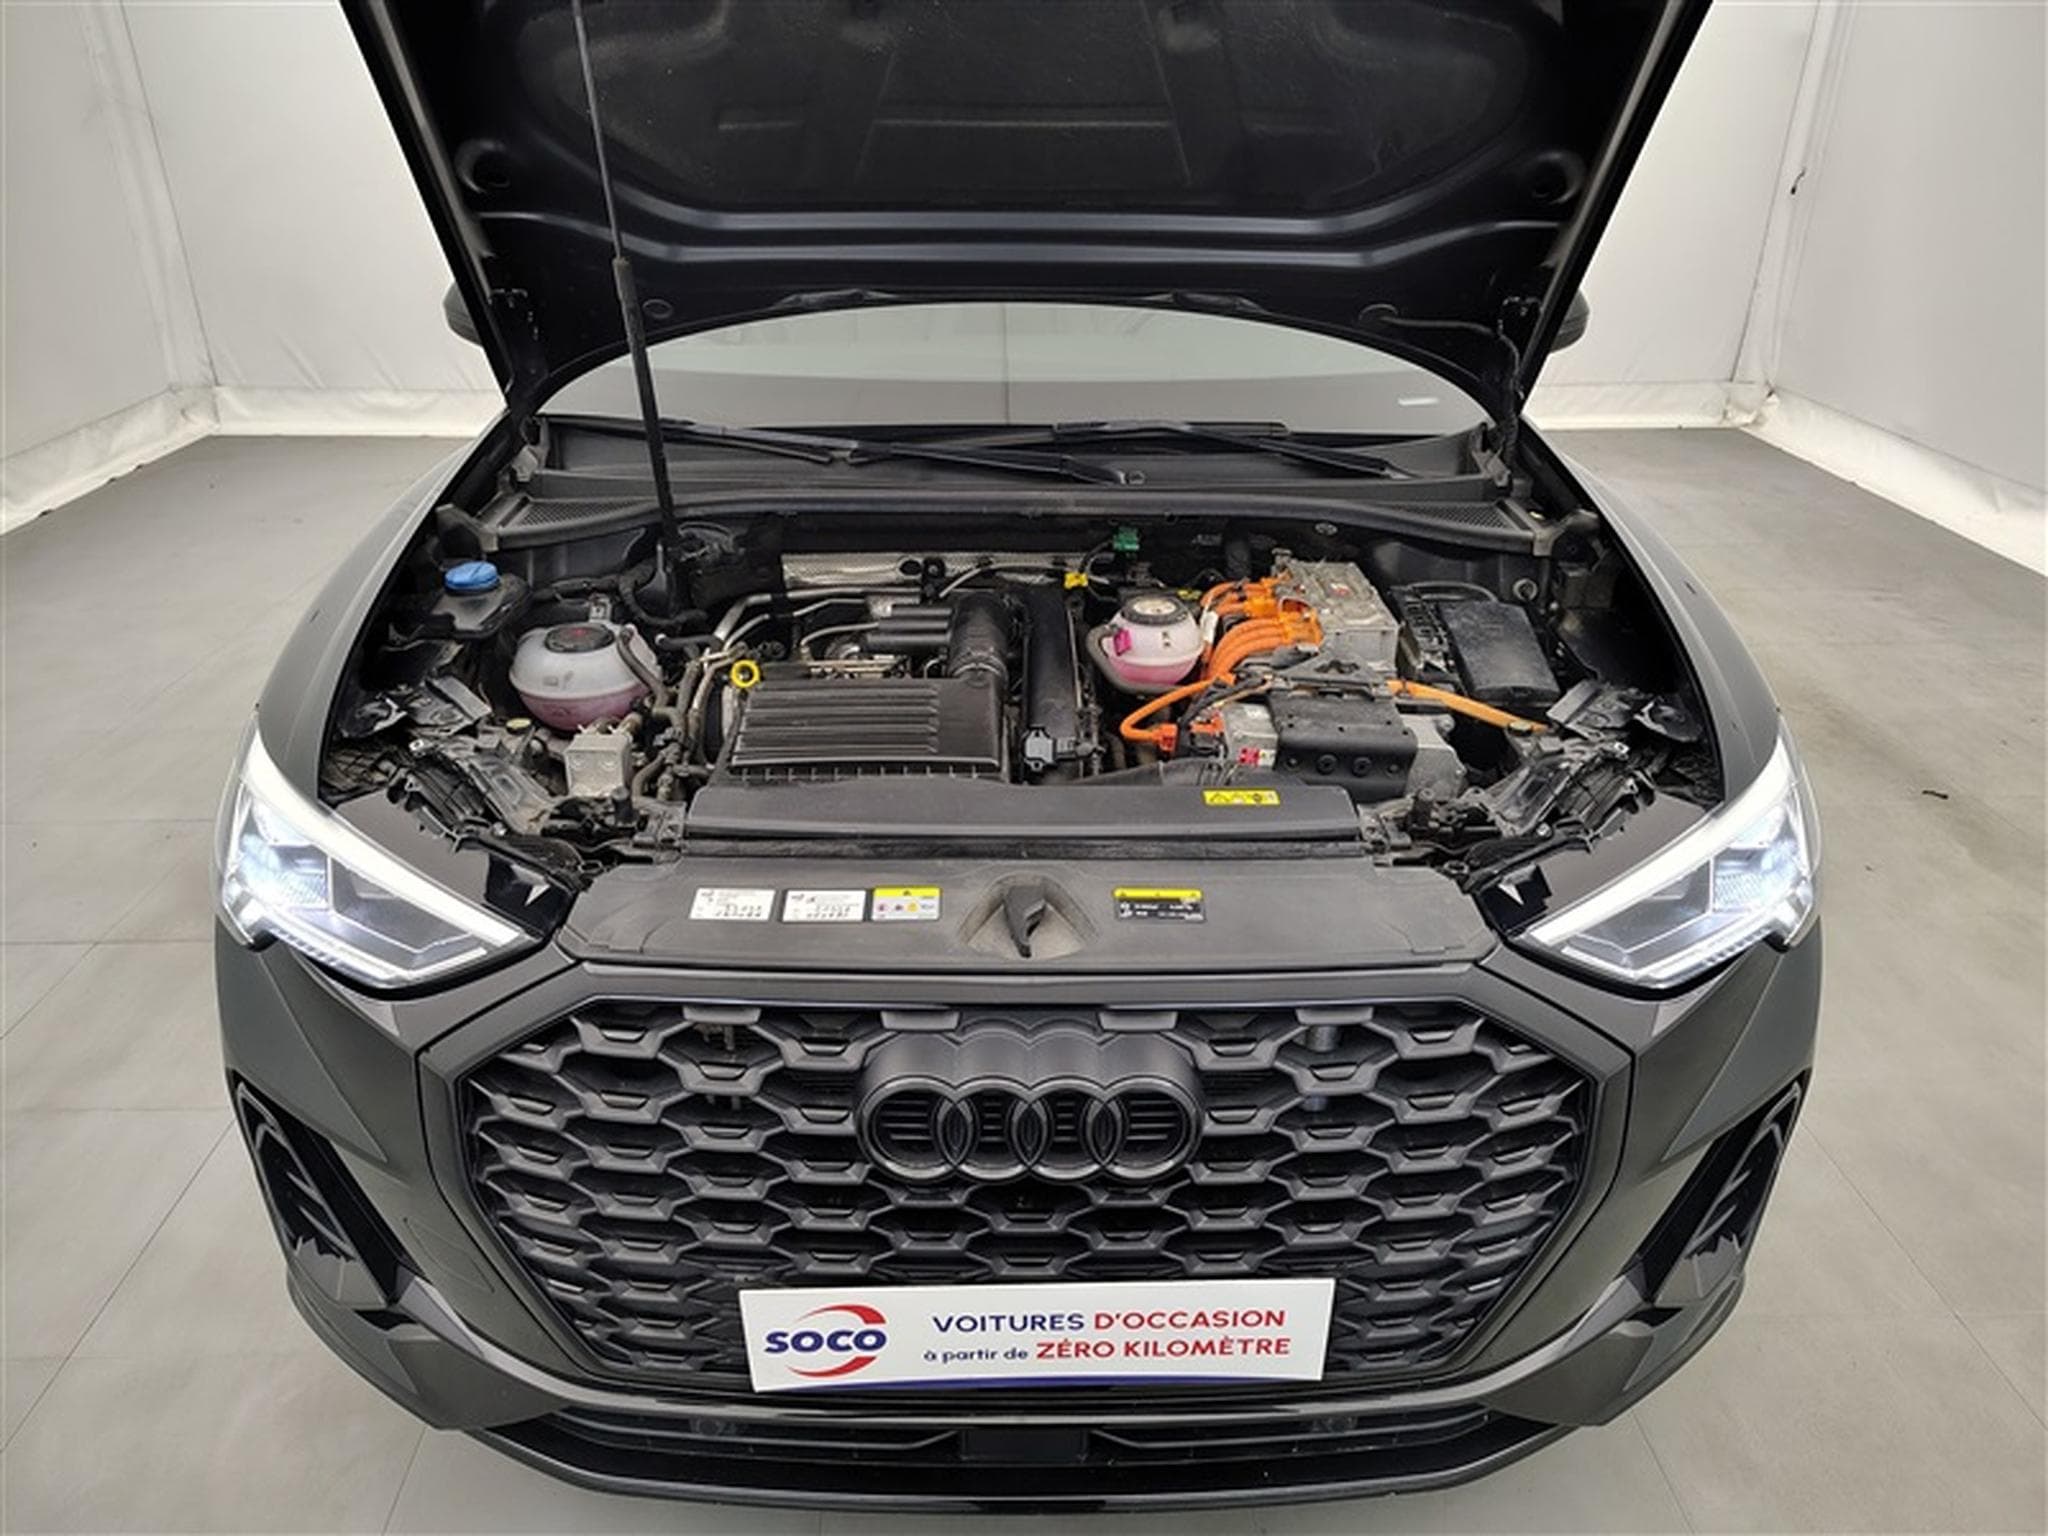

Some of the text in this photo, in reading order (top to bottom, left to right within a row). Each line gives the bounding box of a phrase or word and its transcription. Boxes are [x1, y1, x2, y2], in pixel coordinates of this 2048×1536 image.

[932, 1310, 1285, 1333] VOITURES D'OCCASION
[764, 1328, 887, 1354] SOCO
[923, 1336, 1291, 1363] à partir de ZÉRO KILOMÈTRE
